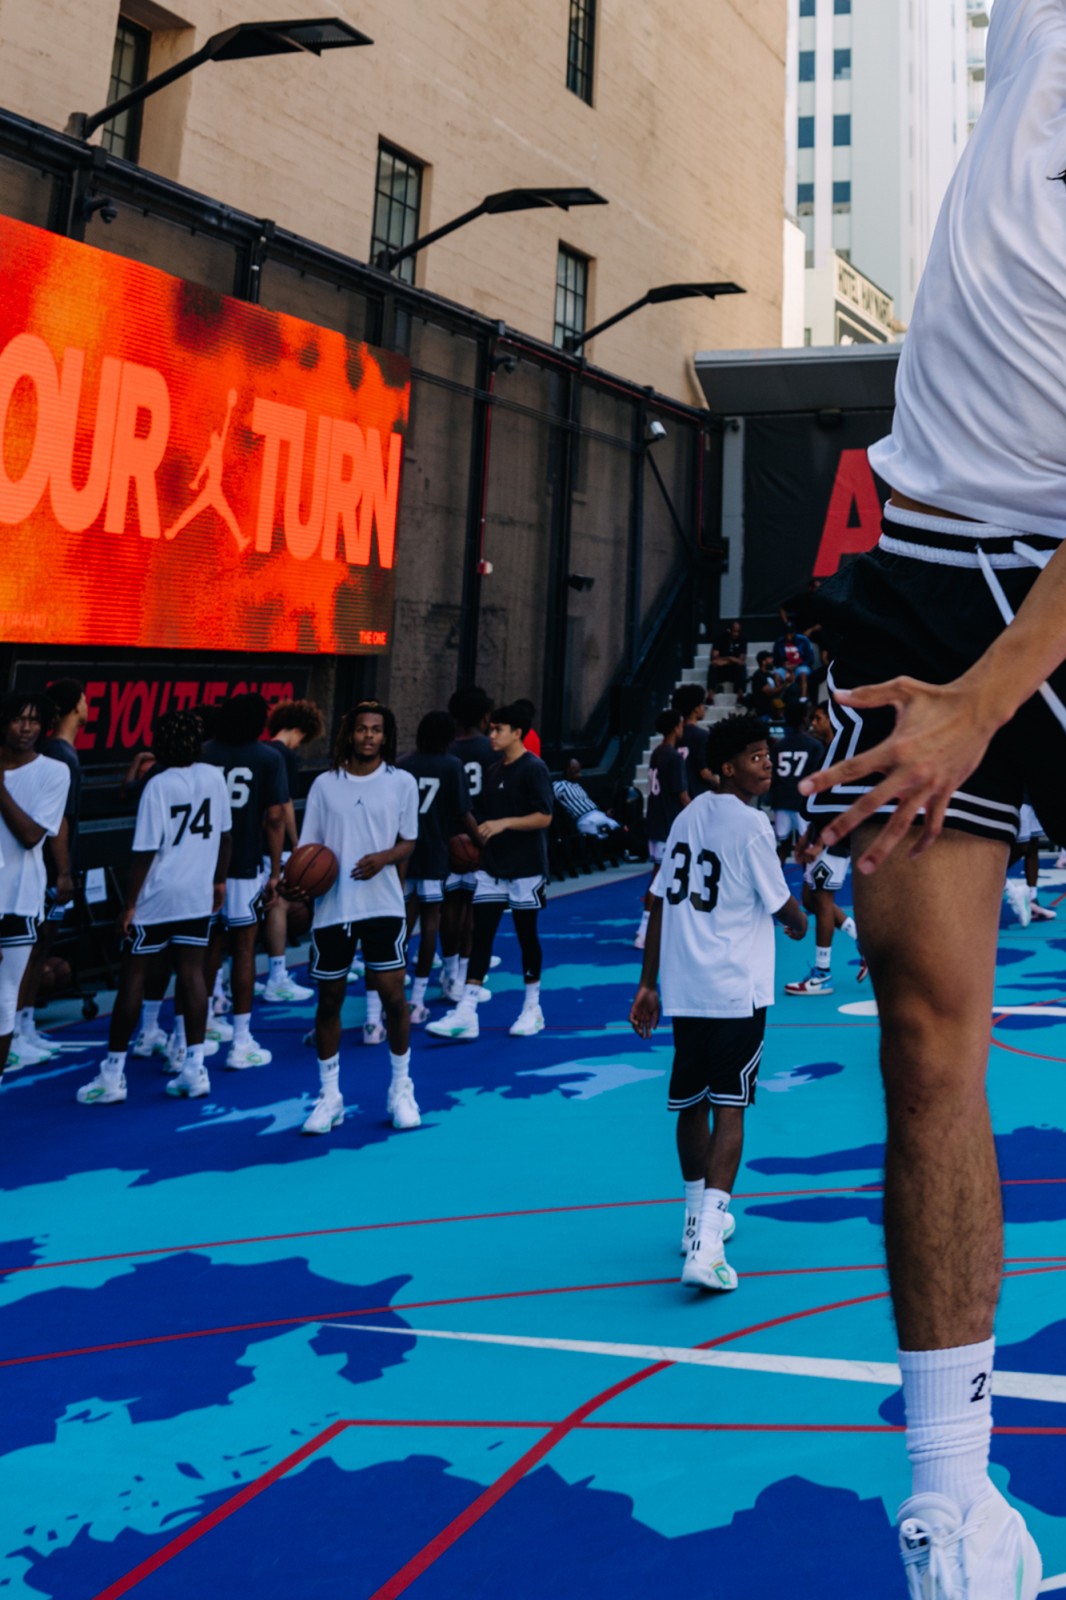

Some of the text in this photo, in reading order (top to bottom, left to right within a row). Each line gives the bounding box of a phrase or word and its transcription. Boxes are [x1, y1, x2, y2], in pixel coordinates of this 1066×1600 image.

[0, 332, 402, 569] OUR TURN
[217, 766, 253, 809] 6
[777, 751, 809, 777] 57
[170, 797, 213, 847] 74
[666, 841, 721, 913] 33
